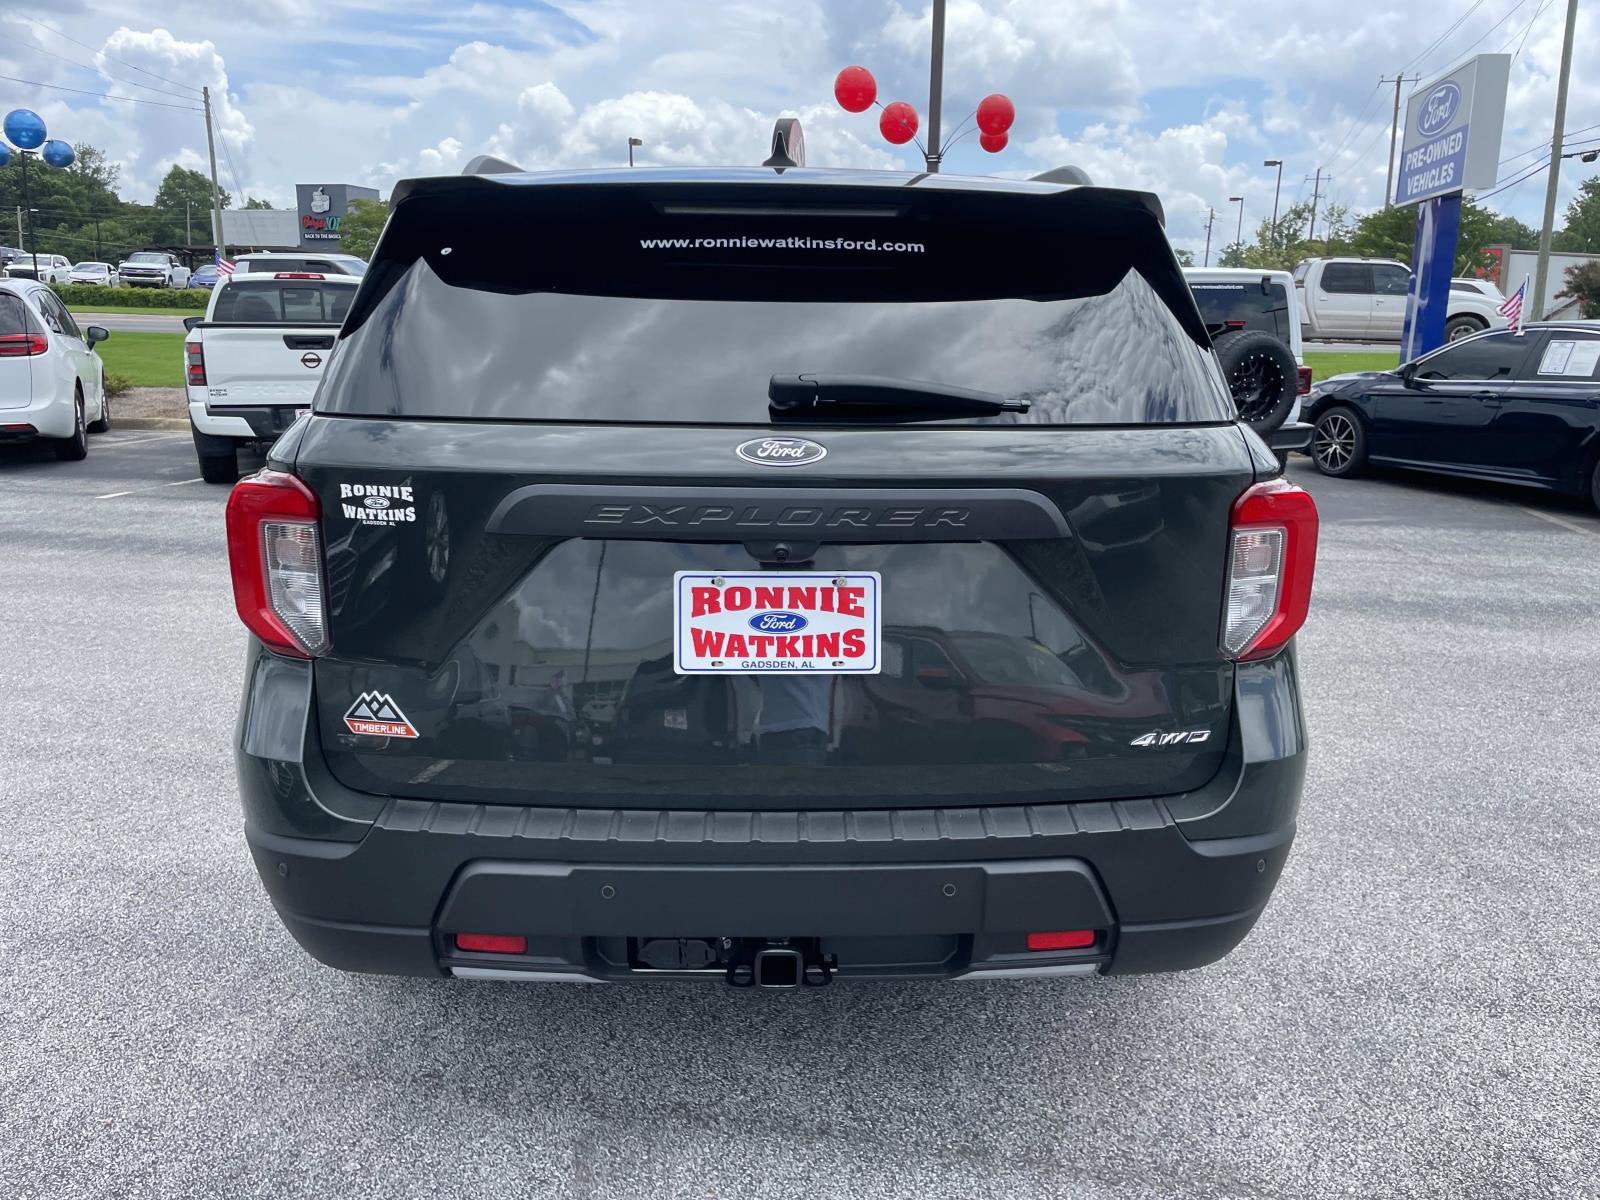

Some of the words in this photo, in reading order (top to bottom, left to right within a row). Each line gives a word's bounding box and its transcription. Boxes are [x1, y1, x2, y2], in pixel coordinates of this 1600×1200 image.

[1424, 88, 1453, 129] Ford
[1405, 131, 1463, 172] PRE-OWNED
[1407, 162, 1455, 195] VEHICLES
[640, 236, 926, 253] www.ronniewatkinsford.com
[757, 440, 806, 458] Ford
[340, 483, 414, 503] RONNIE
[341, 503, 417, 522] WATKINS
[583, 504, 971, 527] EXPLORER
[691, 586, 865, 619] RONNIE
[759, 614, 796, 630] Ford
[690, 627, 866, 659] WATKINS
[741, 660, 798, 670] GADSDEN,
[800, 660, 816, 669] AL
[353, 722, 407, 735] TIMBERLINE
[1130, 730, 1212, 747] 4WD
